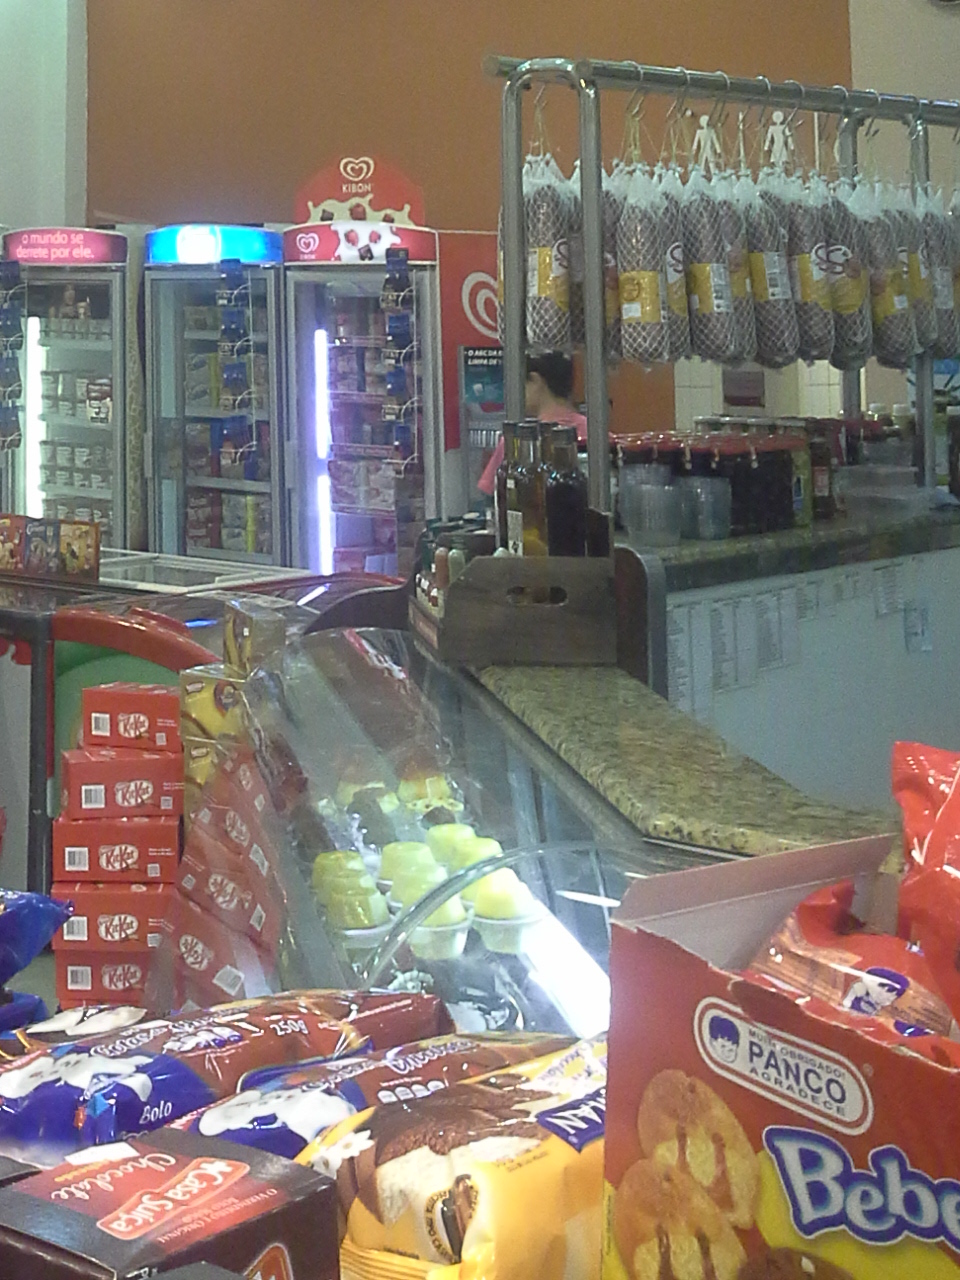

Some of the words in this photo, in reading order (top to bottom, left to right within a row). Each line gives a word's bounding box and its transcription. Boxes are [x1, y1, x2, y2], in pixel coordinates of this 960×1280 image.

[341, 183, 372, 194] KIBON
[21, 234, 29, 245] o
[30, 231, 68, 245] mundo
[70, 233, 84, 245] se
[16, 245, 49, 259] derrete
[50, 247, 71, 261] por
[72, 245, 95, 259] ele.
[122, 714, 149, 737] KitKat
[123, 781, 153, 804] KitKat
[106, 845, 138, 870] KitKat
[105, 916, 137, 939] KitKat
[269, 1019, 309, 1037] 250g
[747, 1038, 847, 1107] PANCO
[748, 1066, 847, 1117] AGRADECE
[139, 1100, 173, 1125] Bolo
[52, 1153, 177, 1200] Chocolate
[165, 1167, 224, 1201] Casa
